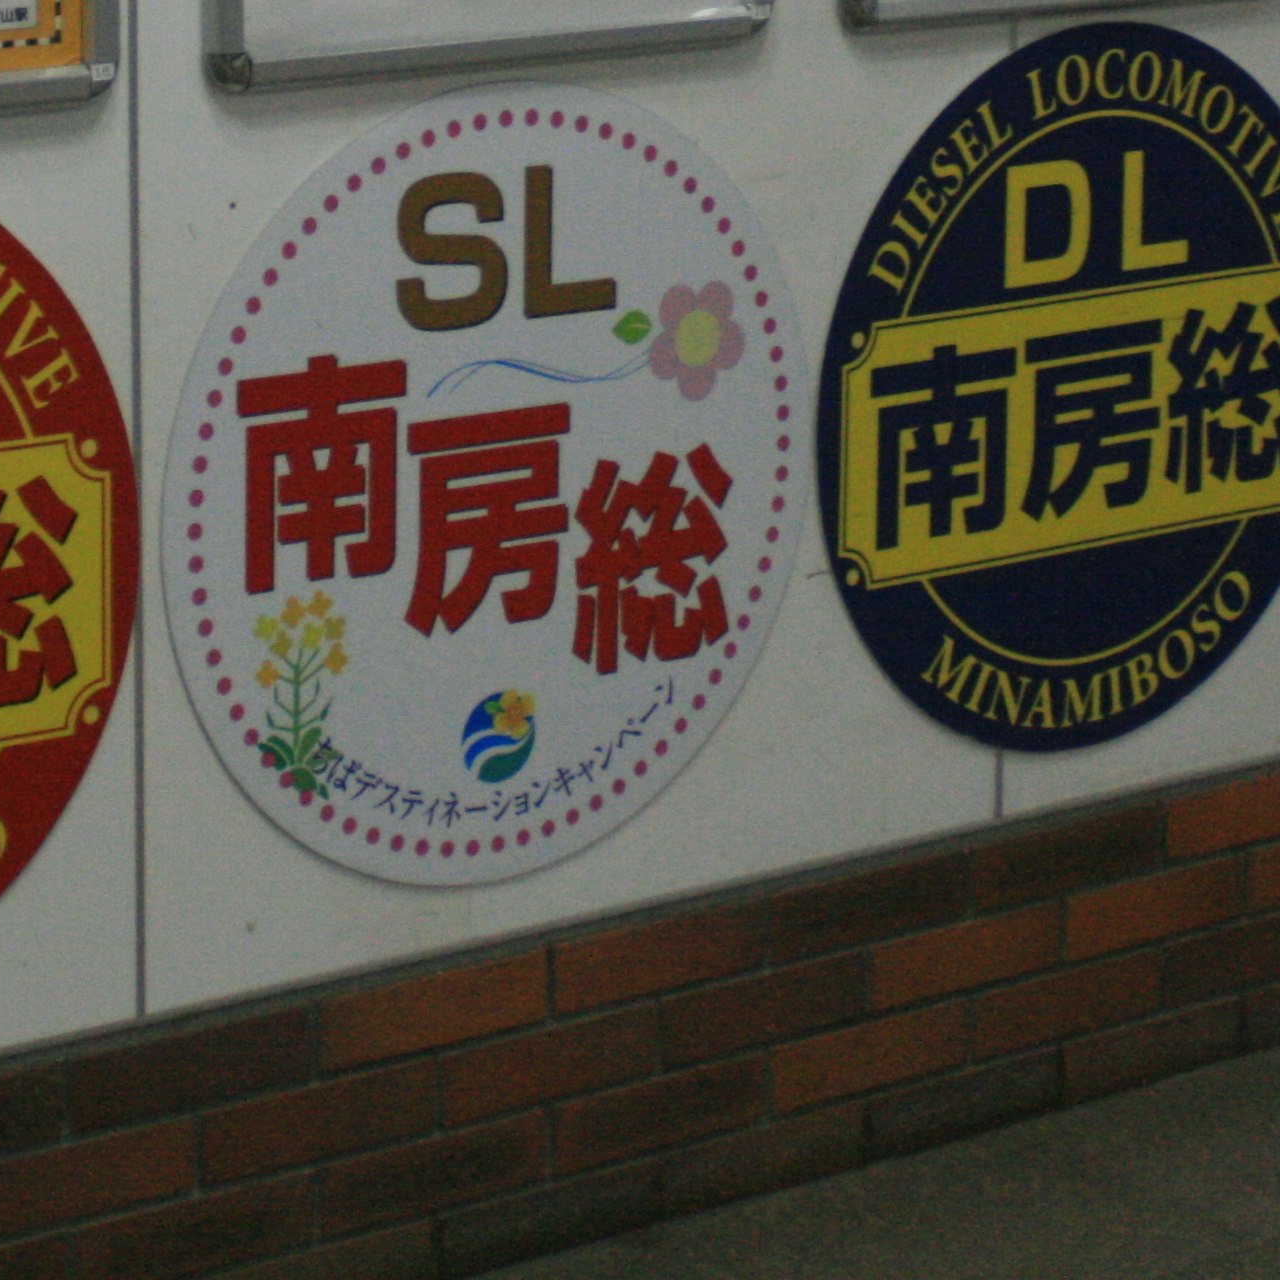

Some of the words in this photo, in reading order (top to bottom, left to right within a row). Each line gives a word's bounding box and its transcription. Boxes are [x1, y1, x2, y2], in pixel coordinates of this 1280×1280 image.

[395, 163, 618, 333] SL
[866, 98, 1015, 296] DIESEL
[1002, 149, 1190, 291] DL
[235, 353, 734, 675] 南房総
[921, 567, 1253, 730] MINAMIBOSO
[311, 675, 677, 828] ちばデスティネーションキャンペーン
